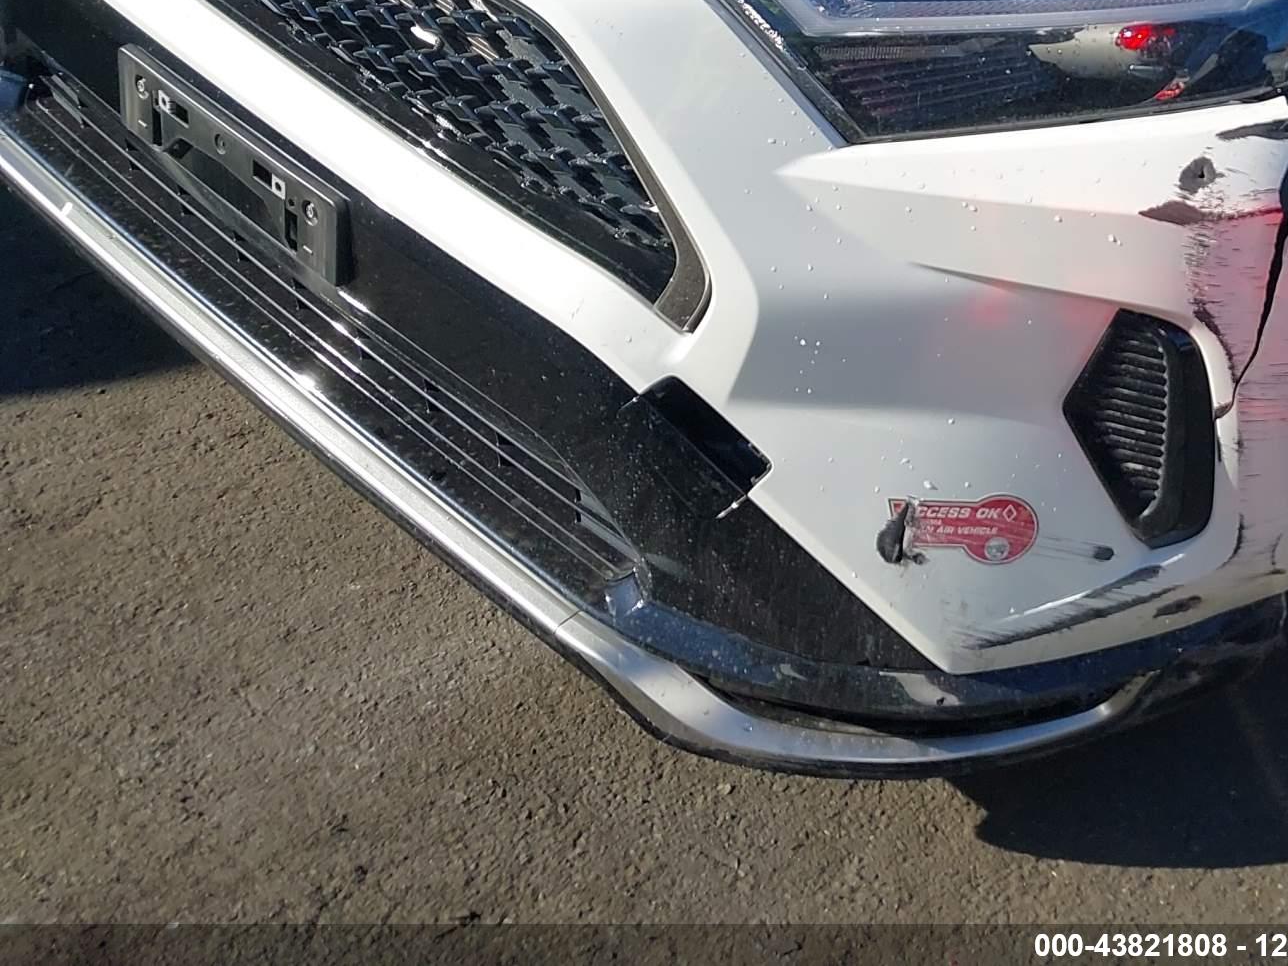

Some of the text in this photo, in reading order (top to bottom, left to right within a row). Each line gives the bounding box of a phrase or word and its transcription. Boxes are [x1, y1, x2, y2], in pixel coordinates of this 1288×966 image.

[914, 506, 1000, 519] CCESS OK
[957, 525, 998, 534] VEHICLE
